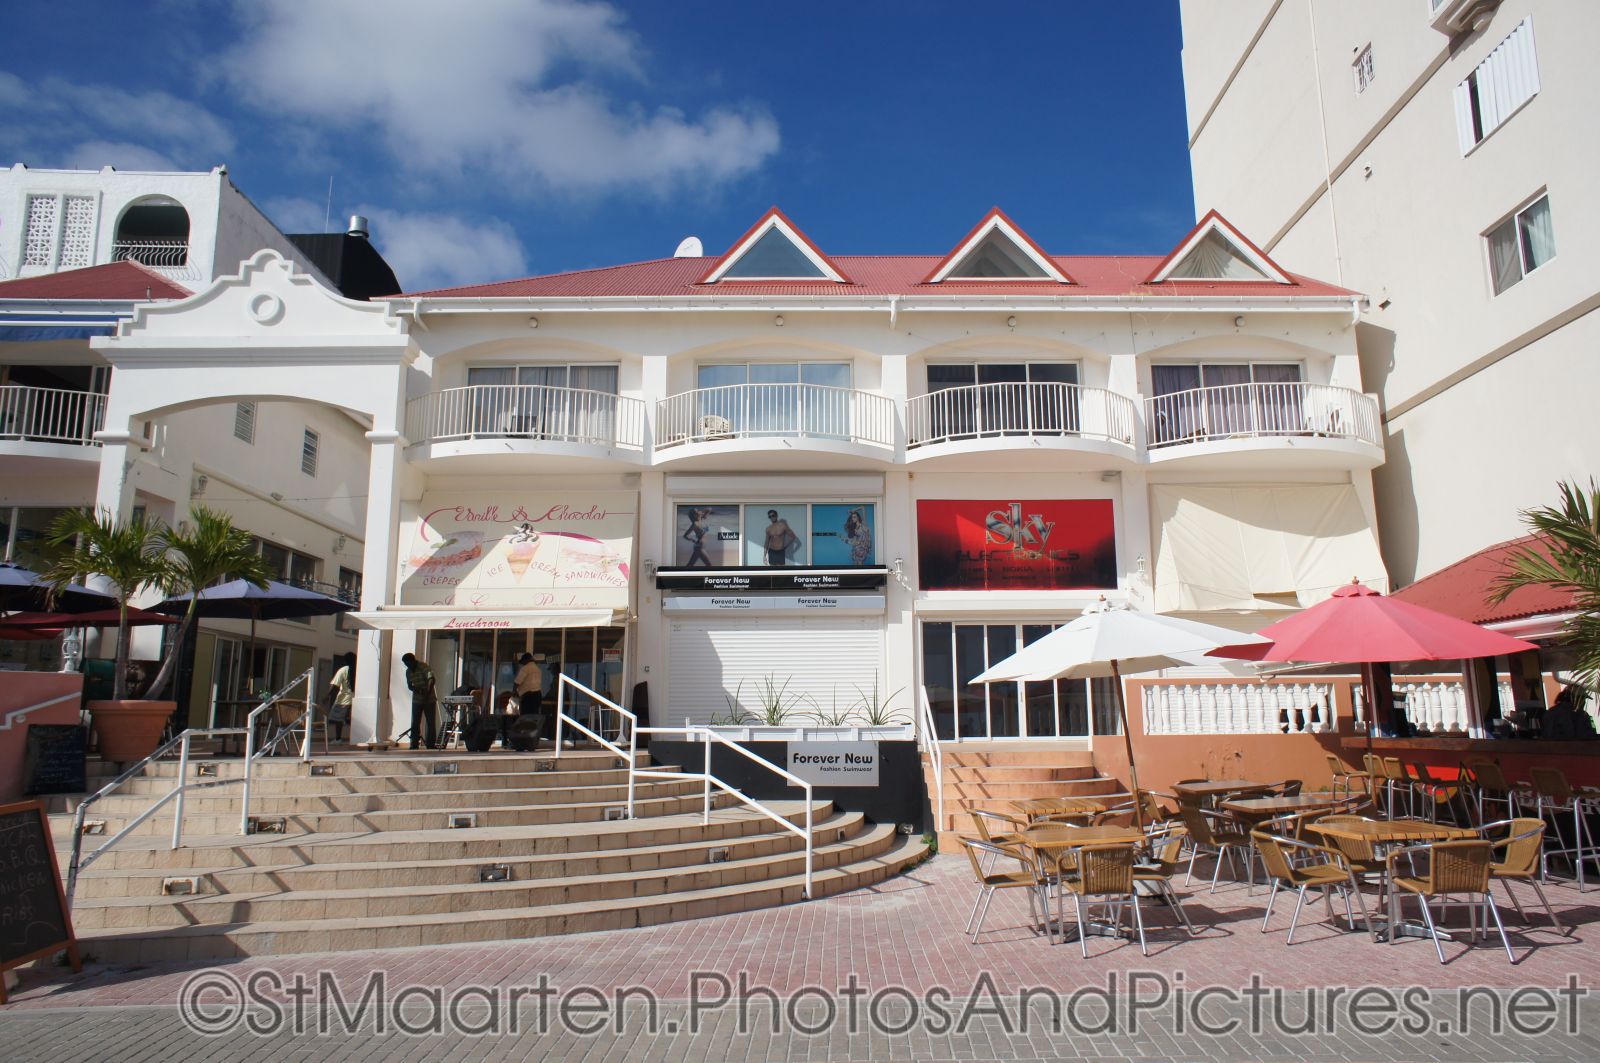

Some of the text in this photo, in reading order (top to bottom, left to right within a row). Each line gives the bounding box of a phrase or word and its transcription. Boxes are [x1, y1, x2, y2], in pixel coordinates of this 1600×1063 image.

[547, 504, 607, 521] Chocolat
[985, 502, 1056, 551] Sky
[486, 562, 560, 578] ICE CREAM
[423, 577, 461, 586] CREPES
[564, 571, 625, 587] SANDWICHES
[443, 617, 511, 628] Lunchroom
[793, 753, 873, 764] Forever New
